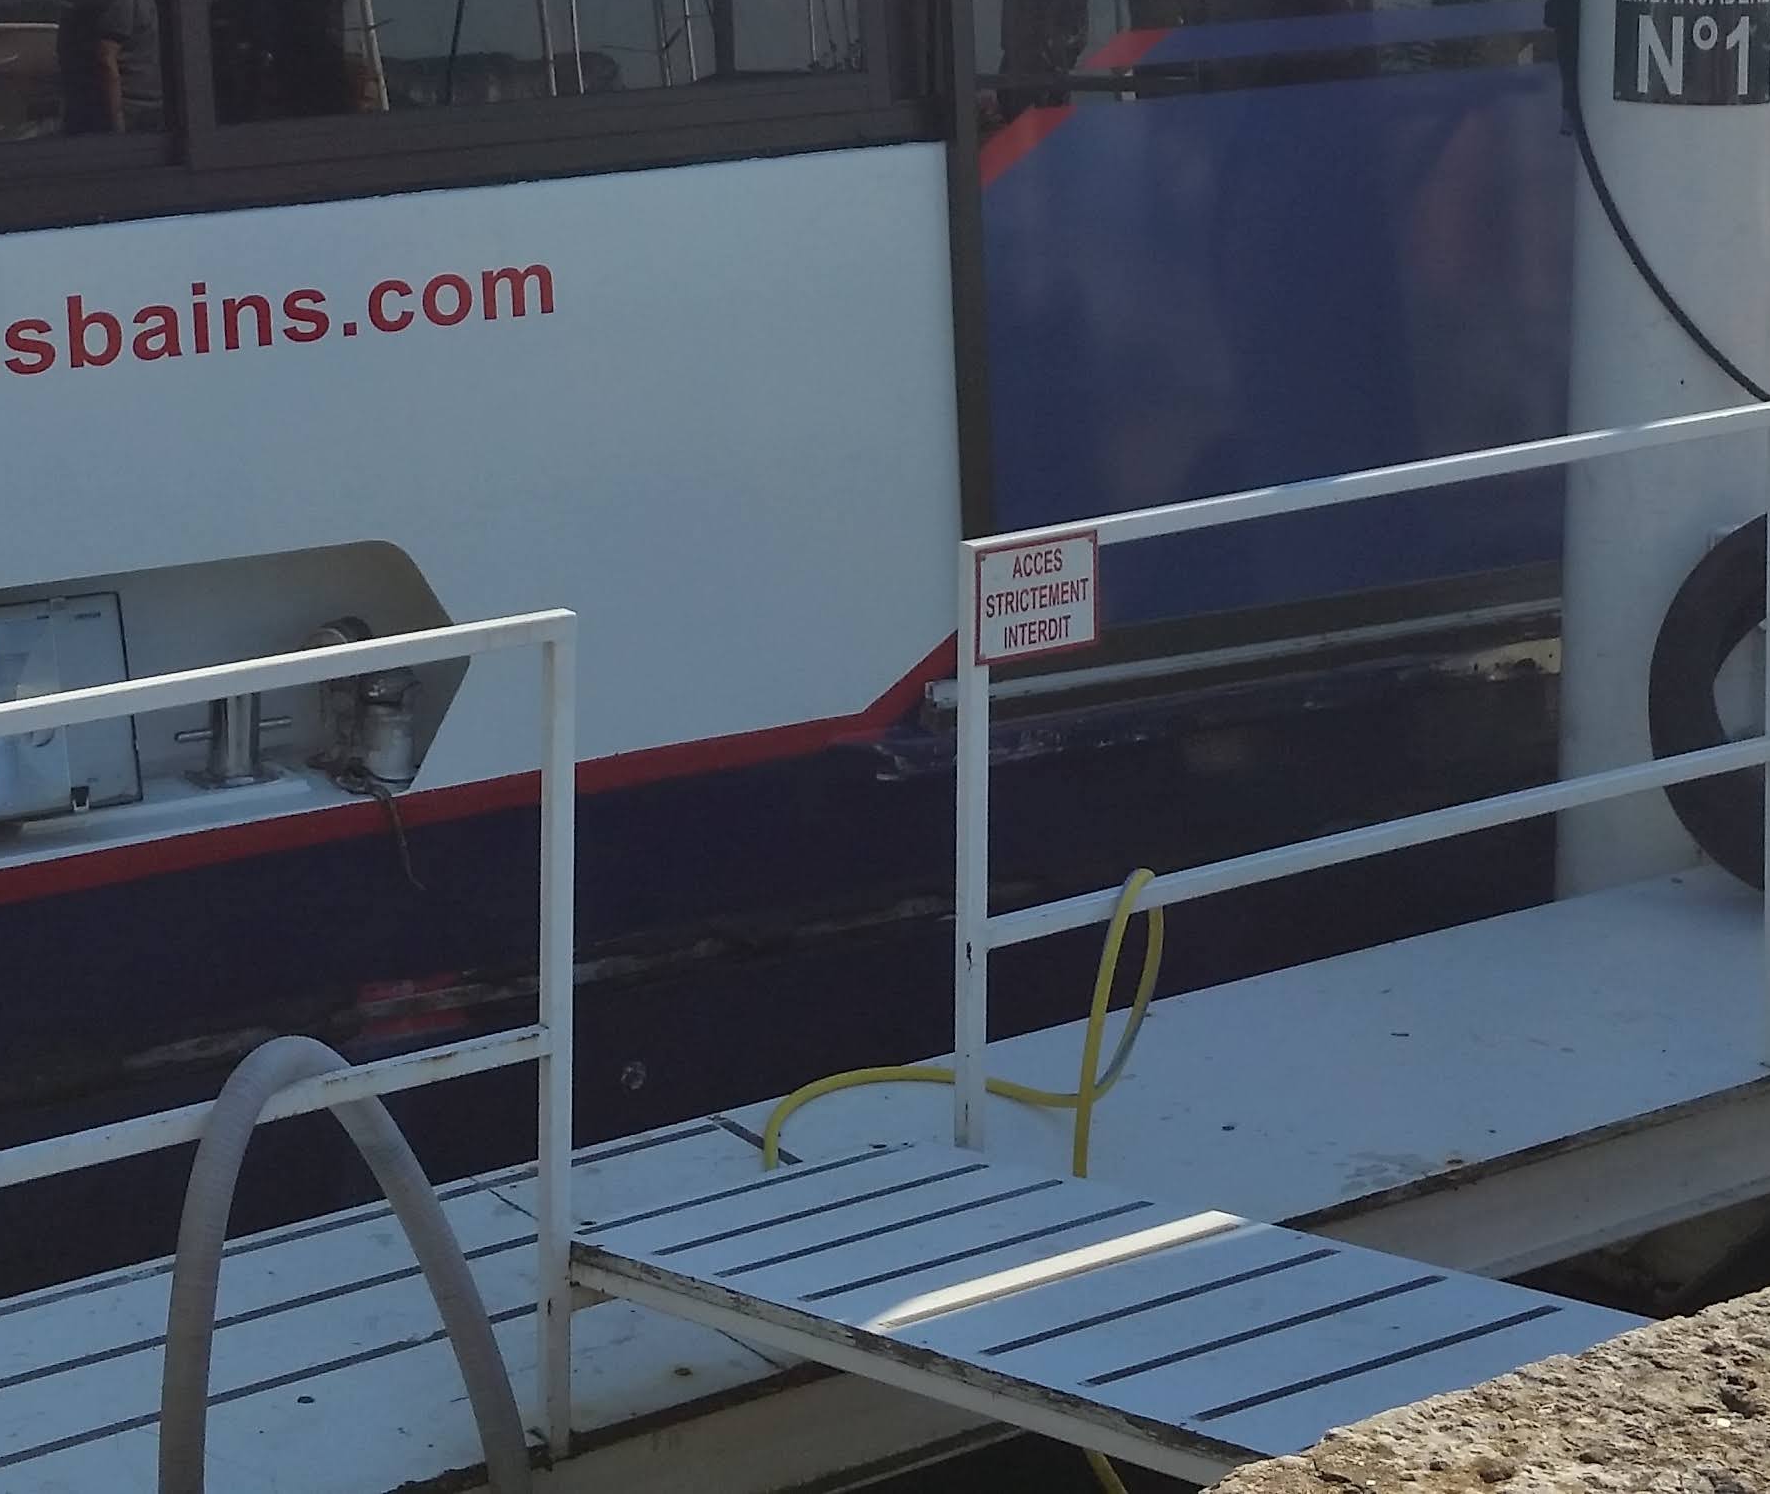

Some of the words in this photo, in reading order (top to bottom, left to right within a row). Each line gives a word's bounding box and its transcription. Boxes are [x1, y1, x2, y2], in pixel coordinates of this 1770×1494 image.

[1637, 14, 1749, 96] N°1
[1012, 548, 1063, 579] ACCES
[986, 578, 1089, 618] STRICTEMENT
[1004, 615, 1071, 649] INTERDIT
